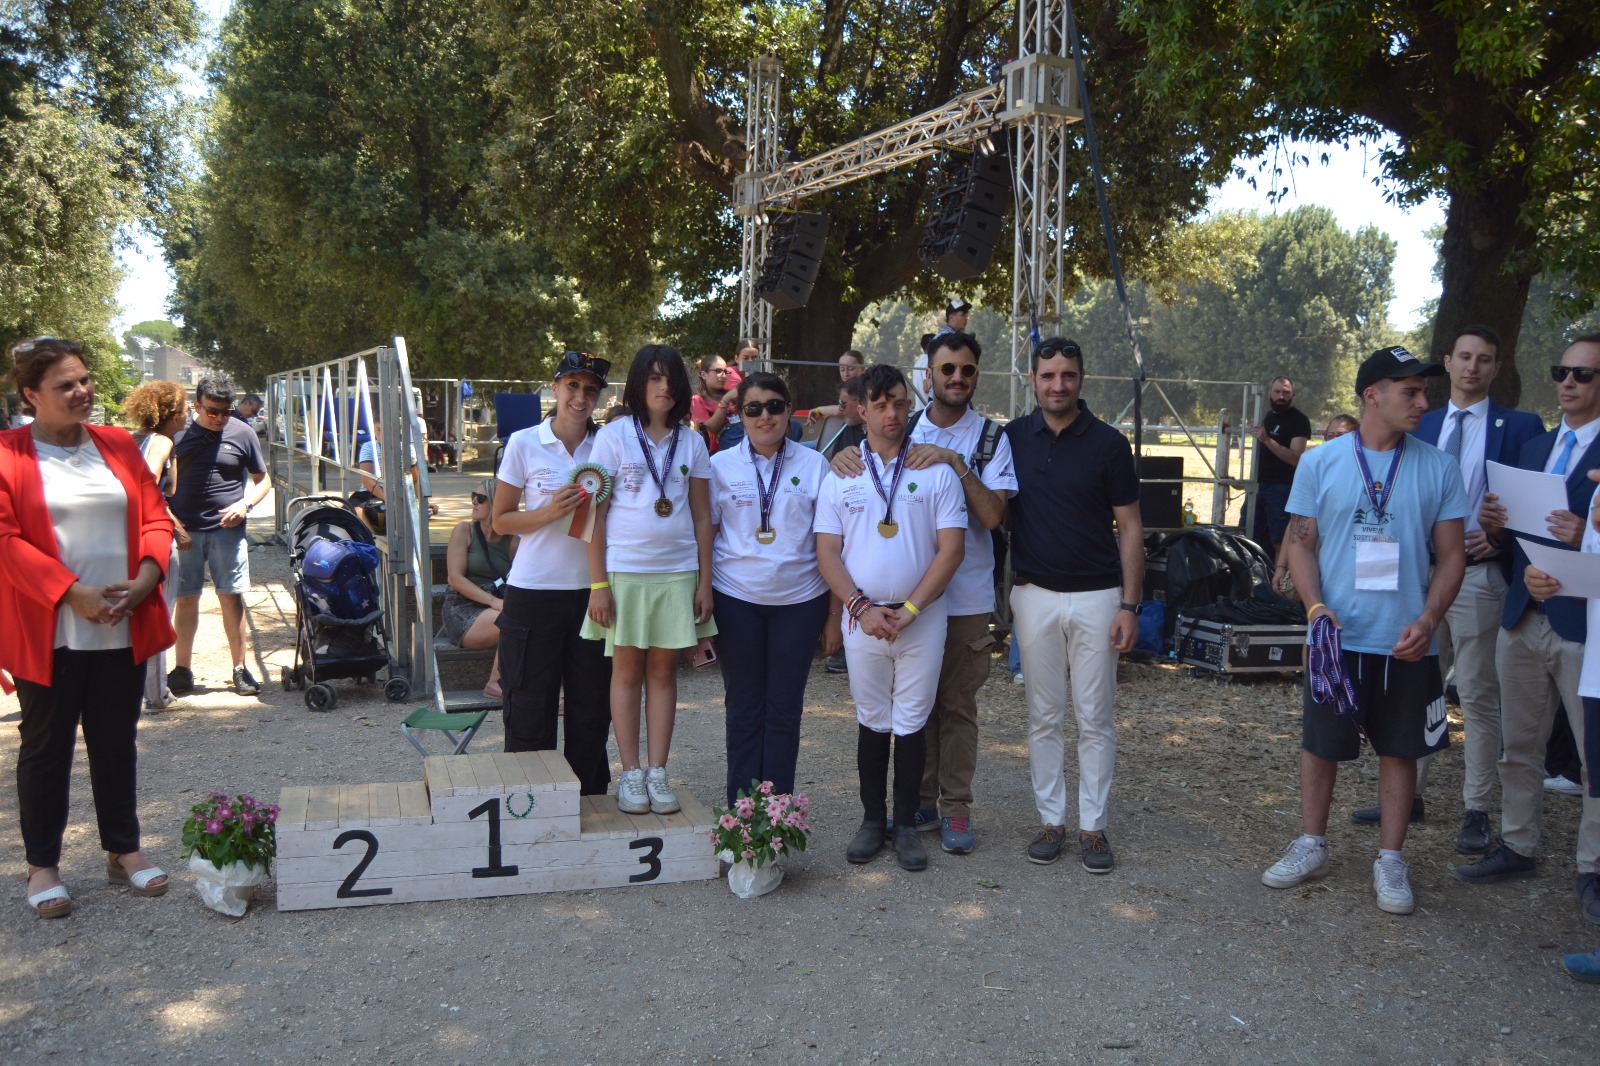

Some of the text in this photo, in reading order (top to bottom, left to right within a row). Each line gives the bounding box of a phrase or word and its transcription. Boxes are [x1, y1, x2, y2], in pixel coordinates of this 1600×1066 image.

[332, 829, 393, 899] 2
[467, 797, 519, 878] 1
[628, 837, 664, 883] 3
